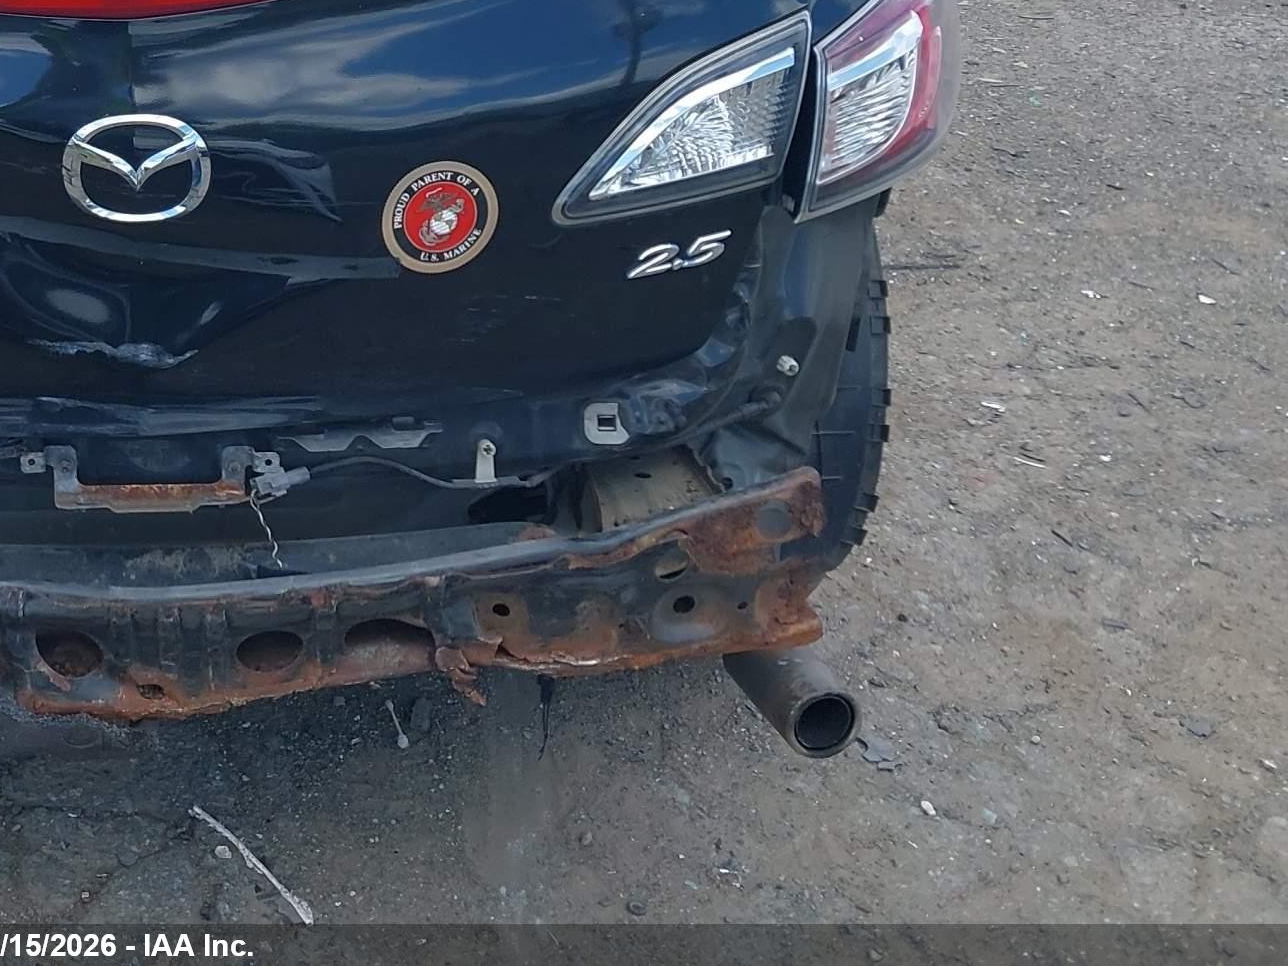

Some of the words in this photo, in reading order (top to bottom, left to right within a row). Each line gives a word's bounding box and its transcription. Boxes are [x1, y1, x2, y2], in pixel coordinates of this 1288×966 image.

[393, 192, 411, 229] PROUD
[411, 171, 455, 192] PARENT
[457, 174, 473, 187] OF
[470, 187, 480, 196] A
[420, 251, 439, 262] U.S.
[443, 228, 482, 261] MARINE
[626, 229, 732, 280] 2.5
